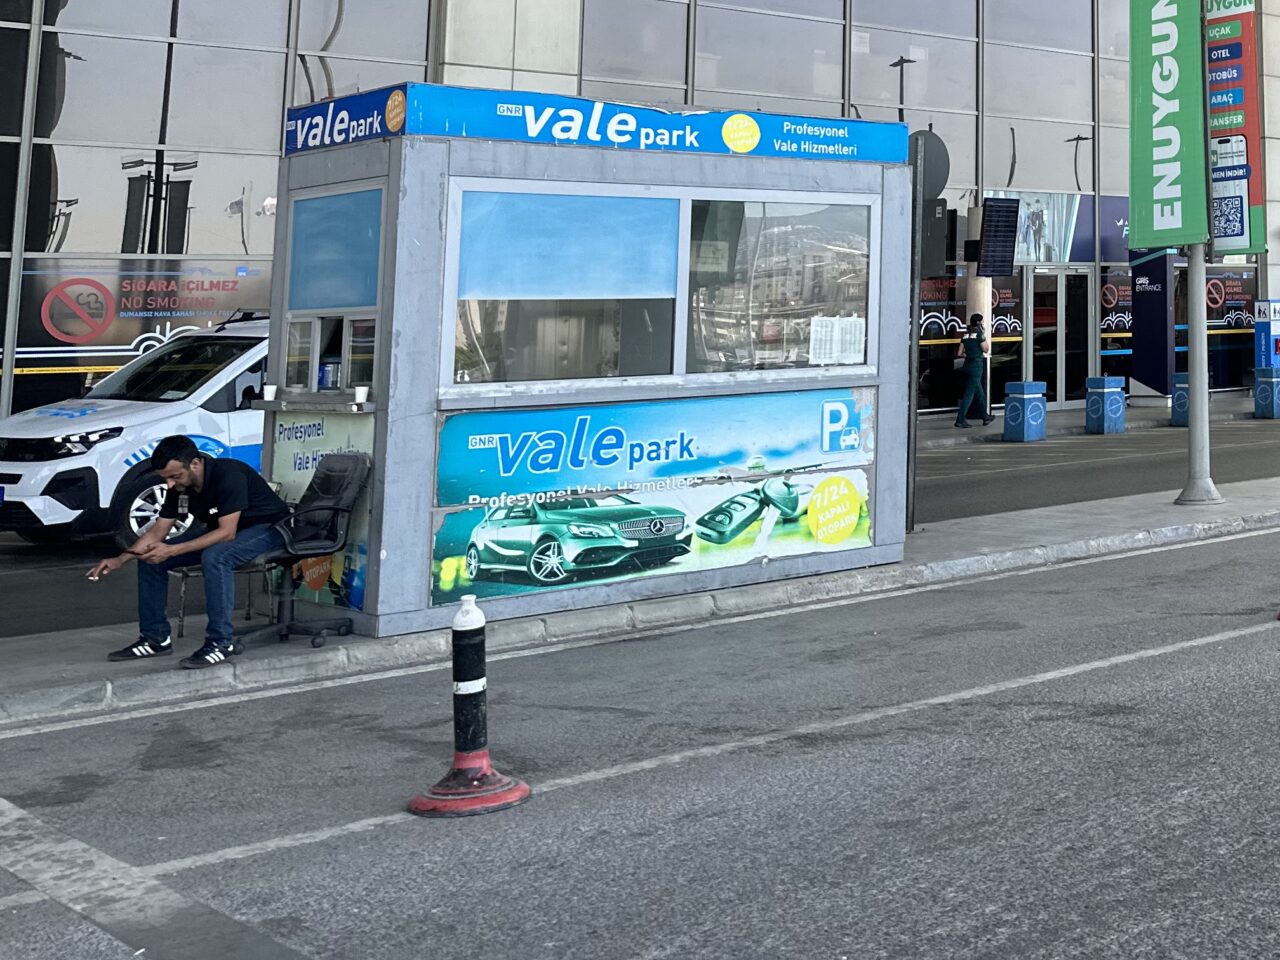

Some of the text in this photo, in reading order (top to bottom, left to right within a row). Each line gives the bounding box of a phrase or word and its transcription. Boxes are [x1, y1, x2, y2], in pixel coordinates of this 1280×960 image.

[1209, 26, 1231, 38] UÇAK
[1211, 49, 1230, 59] OTEL
[1211, 93, 1233, 105] ARAÇ
[498, 105, 521, 115] GNR
[296, 103, 349, 148] vale
[350, 111, 381, 141] park
[524, 102, 636, 143] vale
[640, 125, 699, 149] park
[1211, 114, 1243, 127] RANSFER
[783, 122, 849, 139] Profesyonel
[773, 139, 858, 156] Vale Hizmetleri
[1212, 169, 1225, 179] MEN
[121, 297, 217, 309] NO SMOKING
[278, 417, 324, 442] Profesyonel
[823, 402, 848, 451] P
[470, 437, 494, 448] GNR
[496, 416, 697, 476] vale park
[293, 452, 310, 472] Vale
[813, 480, 848, 509] 7/24
[817, 513, 856, 540] OTOPARK
